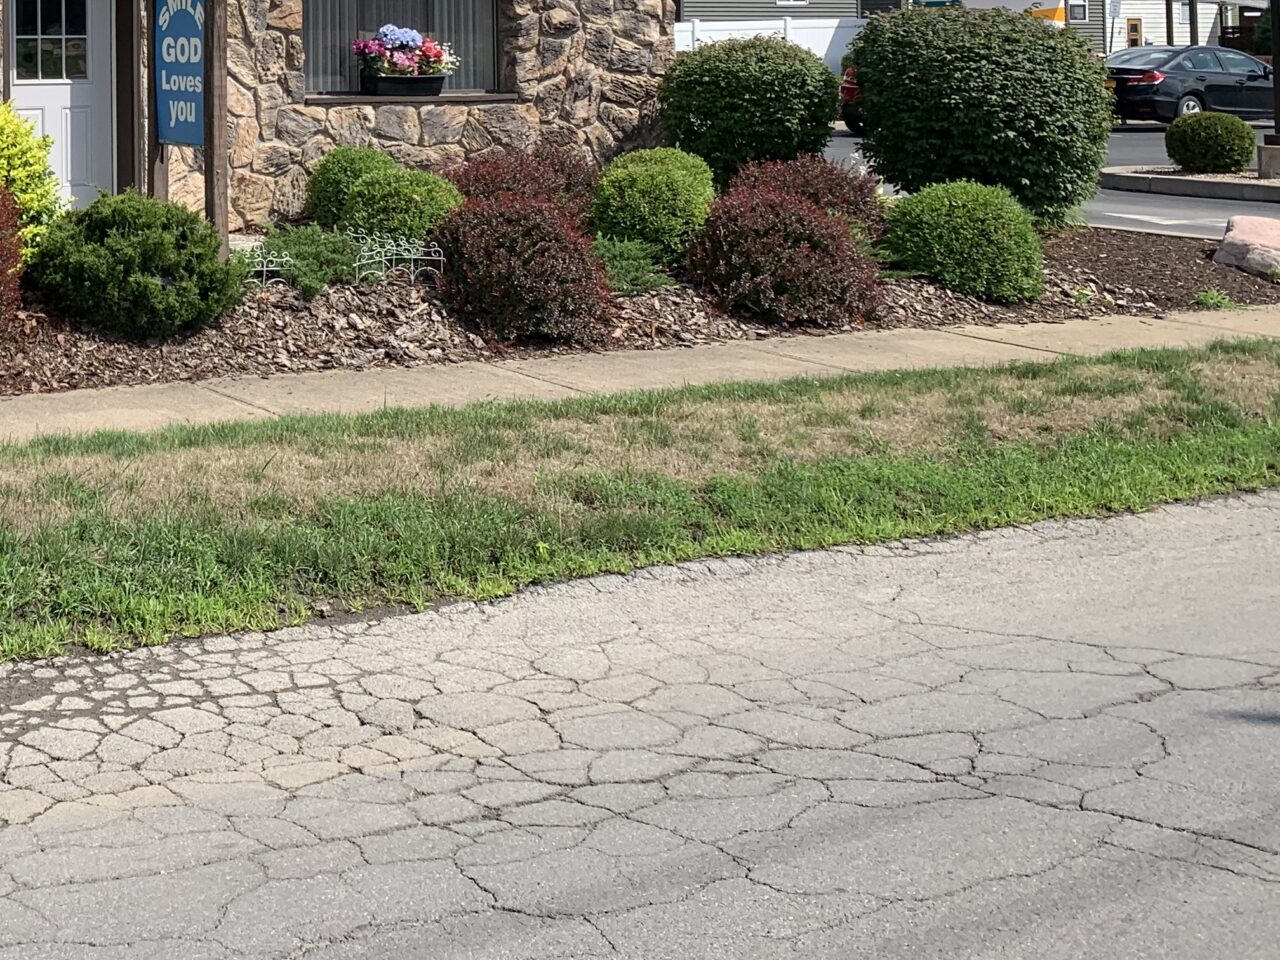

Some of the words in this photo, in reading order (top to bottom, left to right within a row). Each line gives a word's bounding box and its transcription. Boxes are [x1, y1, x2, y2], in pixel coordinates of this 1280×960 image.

[162, 37, 202, 63] GOD
[161, 70, 202, 93] Loves
[169, 100, 196, 128] you
